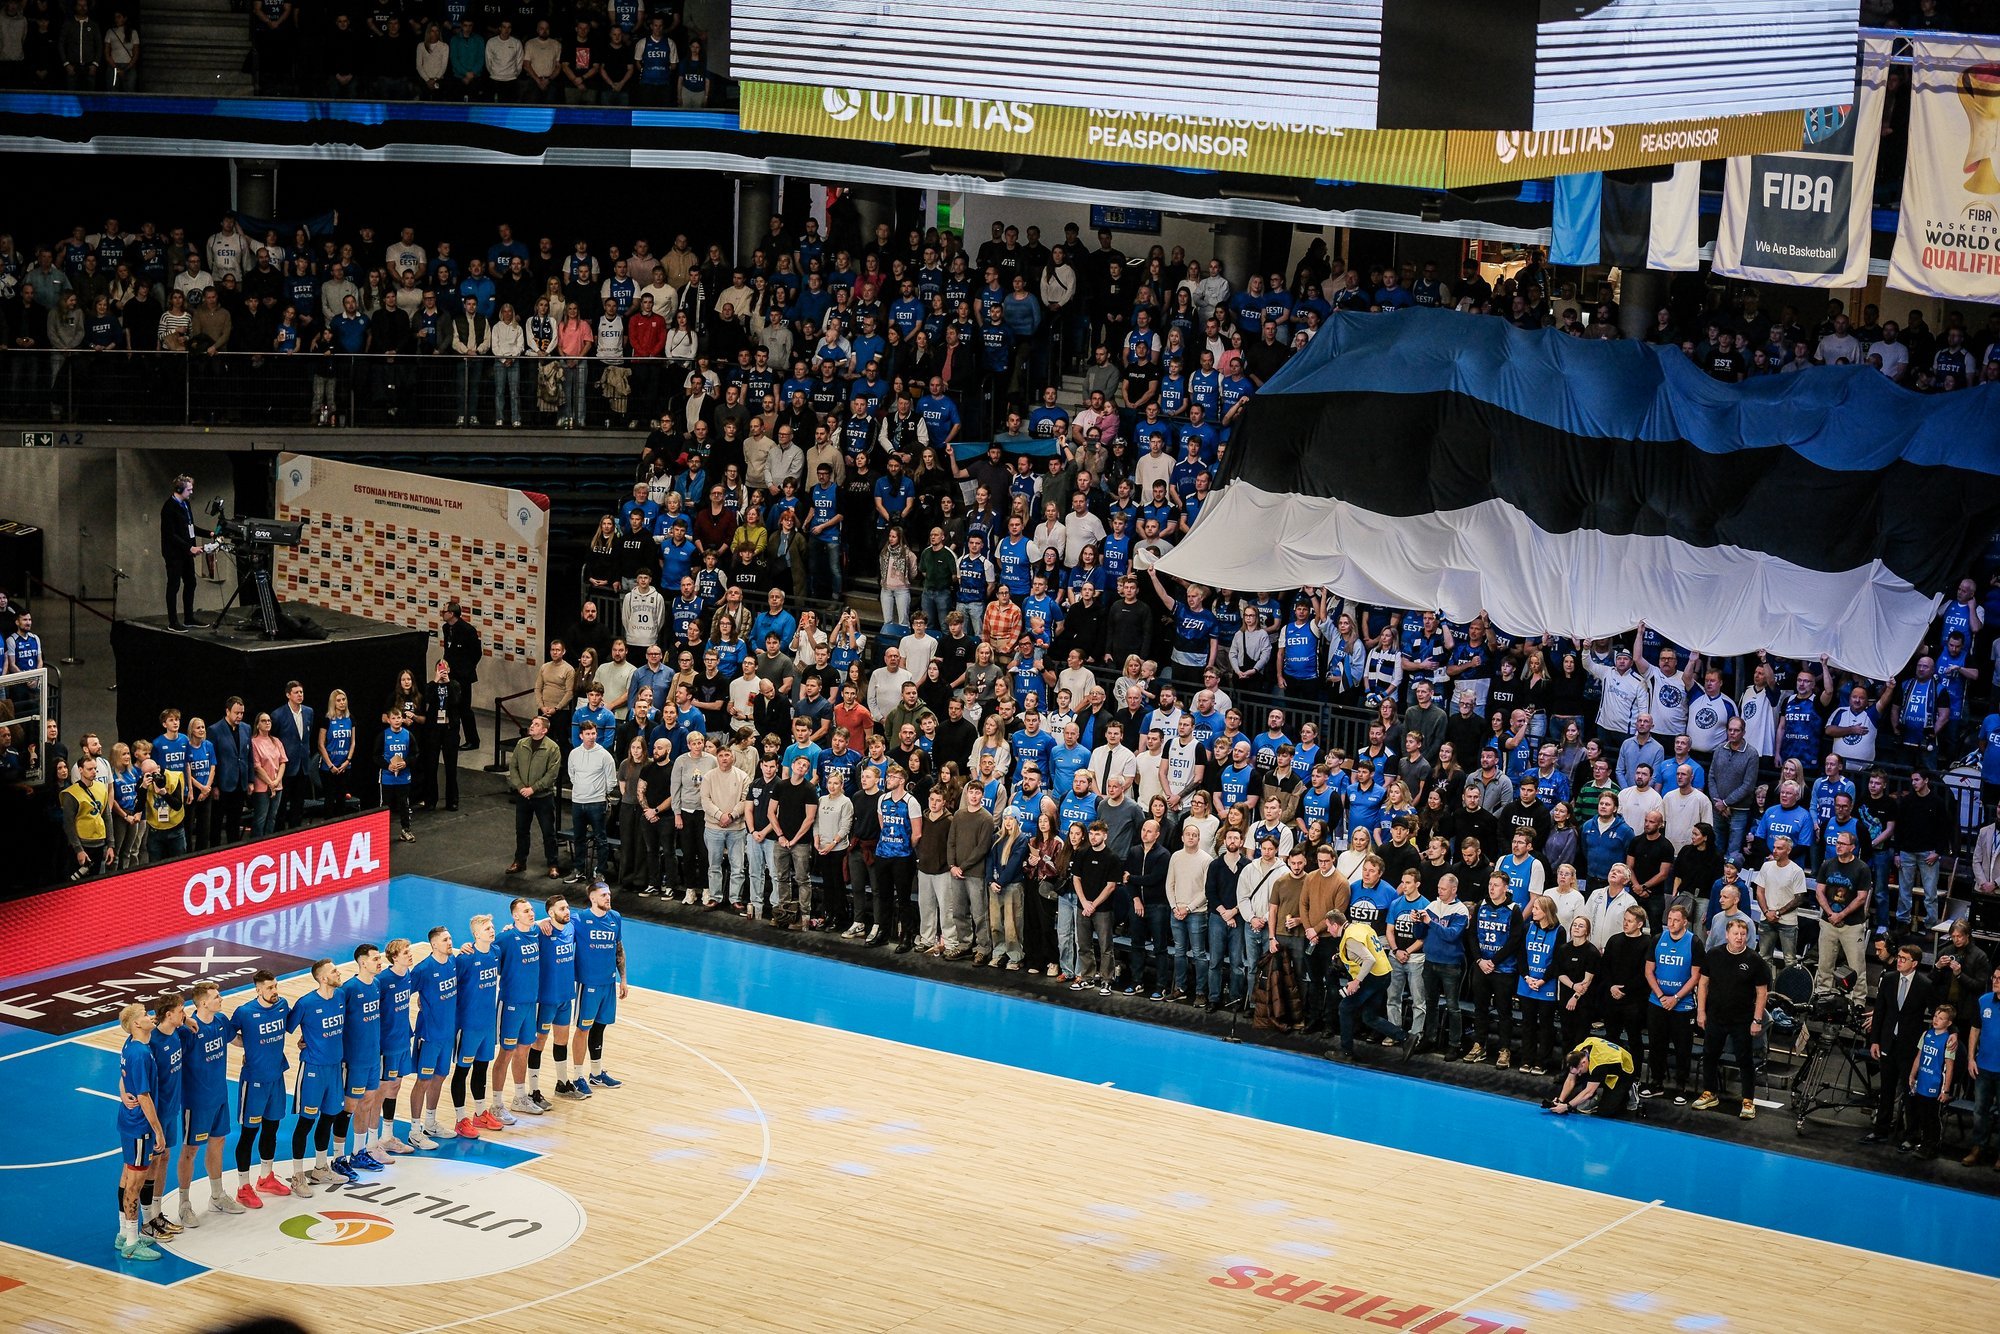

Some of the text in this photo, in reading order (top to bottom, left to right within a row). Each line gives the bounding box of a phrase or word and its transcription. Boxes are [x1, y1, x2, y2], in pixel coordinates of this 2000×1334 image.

[617, 6, 636, 14] EESTI
[870, 91, 1035, 134] UTILITAS
[1089, 126, 1248, 157] PEASPONSOR
[1640, 128, 1719, 153] PEASPONSOR
[1763, 172, 1834, 213] FIBA
[1969, 209, 1991, 221] FIBA
[1926, 230, 1989, 250] WORLD
[217, 249, 236, 257] EESTI
[1756, 241, 1836, 259] We Are Basketball
[293, 285, 313, 294] EESTI
[613, 289, 632, 298] EESTI
[896, 311, 913, 319] EESTI
[1241, 309, 1261, 319] EESTI
[1265, 306, 1283, 315] EESTI
[92, 324, 111, 333] EESTI
[601, 330, 620, 338] EESTI
[983, 333, 1002, 342] EESTI
[1714, 358, 1733, 369] EST
[1193, 384, 1213, 393] EESTI
[1222, 389, 1239, 398] EESTI
[813, 394, 835, 402] EESTI
[1162, 390, 1181, 400] EESTI
[923, 410, 941, 420] EESTI
[908, 421, 915, 431] E
[59, 432, 83, 445] A 2
[846, 430, 867, 439] EESTI
[354, 484, 462, 509] ESTONIAN MEN'S NATIONAL TEAM
[815, 500, 833, 508] EESTI
[819, 509, 827, 517] 33
[623, 540, 641, 550] EESTI
[1001, 555, 1020, 565] EESTI
[1105, 550, 1124, 560] EESTI
[1109, 560, 1118, 568] 29
[960, 569, 981, 579] EESTI
[1005, 566, 1013, 574] 34
[736, 574, 756, 583] EESTI
[699, 580, 716, 588] EESTI
[703, 586, 712, 594] 77
[638, 614, 649, 623] 10
[1026, 609, 1046, 620] EESTI
[1216, 613, 1237, 622] EESTI
[682, 621, 689, 630] 8
[1182, 617, 1204, 630] EESTI
[1945, 616, 1967, 626] EESTI
[1403, 623, 1423, 631] EEST
[1450, 629, 1468, 640] ESTI
[1644, 630, 1654, 639] 13
[1287, 636, 1308, 646] EESTI
[18, 650, 38, 658] EESTI
[842, 650, 848, 659] 0
[27, 658, 34, 667] 0
[1942, 678, 1950, 687] 21
[1493, 691, 1514, 702] EESTI
[1910, 704, 1918, 713] 14
[1785, 713, 1810, 721] EESTI
[332, 729, 351, 738] EESTI
[338, 739, 345, 748] 17
[165, 752, 185, 762] EESTI
[1018, 748, 1039, 757] EESTI
[1169, 757, 1190, 768] EESTI
[1257, 753, 1277, 765] EESTI
[190, 760, 209, 771] EESTI
[1290, 759, 1310, 771] EESTI
[1173, 770, 1182, 778] 99
[1223, 783, 1243, 793] EESTI
[1538, 787, 1554, 796] ESTI
[1226, 794, 1237, 803] 99
[1062, 808, 1088, 821] EESTI
[1305, 806, 1325, 816] EESTI
[1820, 807, 1831, 818] 11
[882, 815, 904, 826] EESTI
[1511, 815, 1534, 827] EESTI
[889, 826, 894, 836] 1
[1769, 822, 1793, 834] EESTI
[183, 831, 380, 916] ORIGINAAL
[1350, 907, 1379, 921] EESTI
[1478, 919, 1507, 933] EESTI
[590, 930, 616, 940] EESTI
[1485, 932, 1496, 943] 13
[521, 942, 539, 955] EESTI
[555, 942, 573, 955] EESTI
[1527, 941, 1551, 954] EESTI
[1532, 954, 1540, 964] 13
[1659, 954, 1684, 967] EESTI
[479, 966, 498, 981] EESTI
[0, 946, 262, 1020] FENIX
[439, 976, 457, 992] EESTI
[73, 1002, 125, 1019] BET
[135, 992, 160, 1002] &
[322, 1014, 344, 1029] EESTI
[259, 1019, 284, 1035] EESTI
[266, 1034, 284, 1043] UTILITAS
[205, 1036, 224, 1053] EESTI
[1923, 1044, 1938, 1056] EESTI
